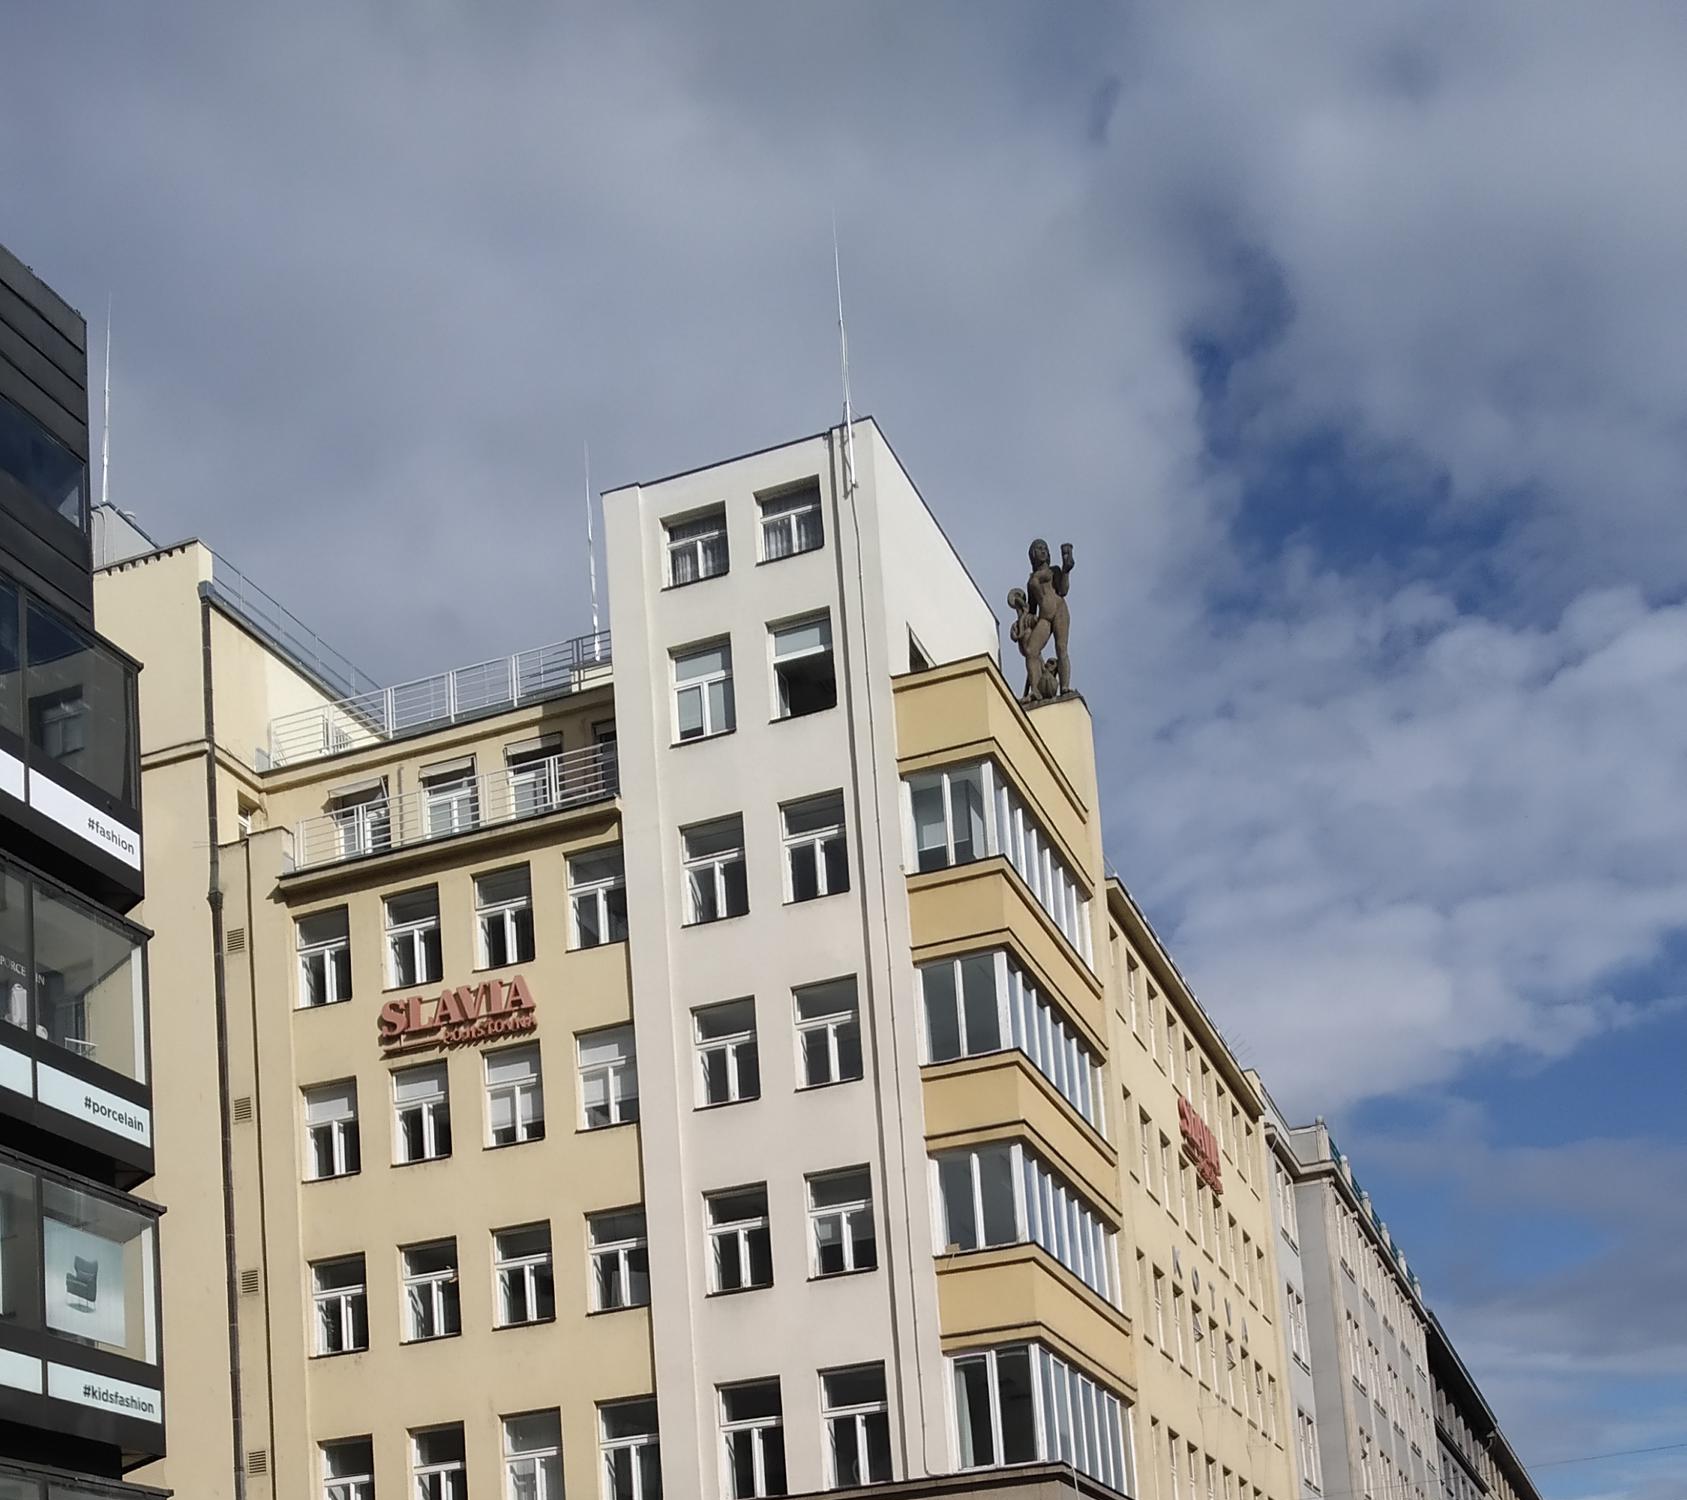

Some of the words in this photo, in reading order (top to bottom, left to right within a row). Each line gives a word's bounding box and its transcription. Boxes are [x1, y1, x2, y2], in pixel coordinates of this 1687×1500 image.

[87, 817, 135, 855] #fashion
[380, 974, 537, 1038] SLAVIA
[83, 1095, 145, 1133] #porcelain
[82, 1384, 155, 1414] #kidsfashion
